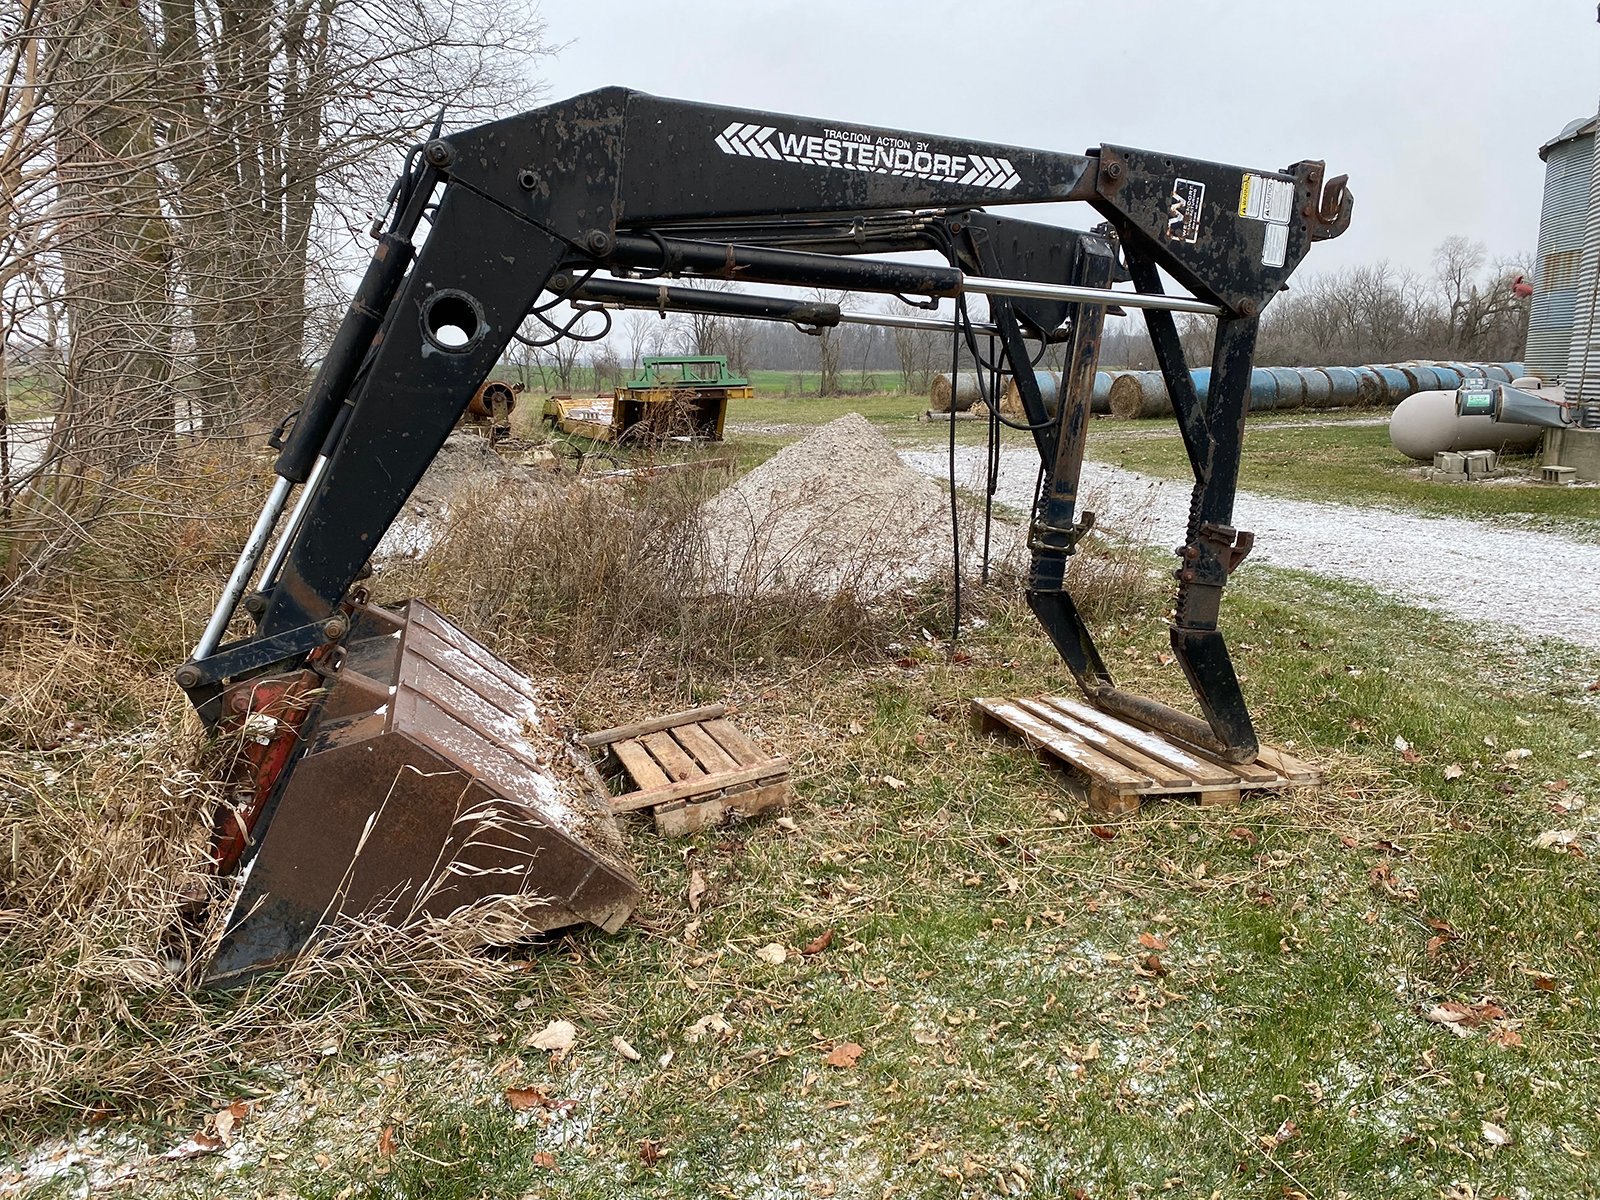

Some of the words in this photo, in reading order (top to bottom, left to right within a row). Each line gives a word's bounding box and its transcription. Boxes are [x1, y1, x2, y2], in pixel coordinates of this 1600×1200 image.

[778, 131, 968, 176] WESTENDORF
[824, 128, 871, 144] TRACTION
[876, 136, 911, 150] ACTION
[916, 141, 930, 152] BY
[1264, 181, 1274, 210] CAUTION
